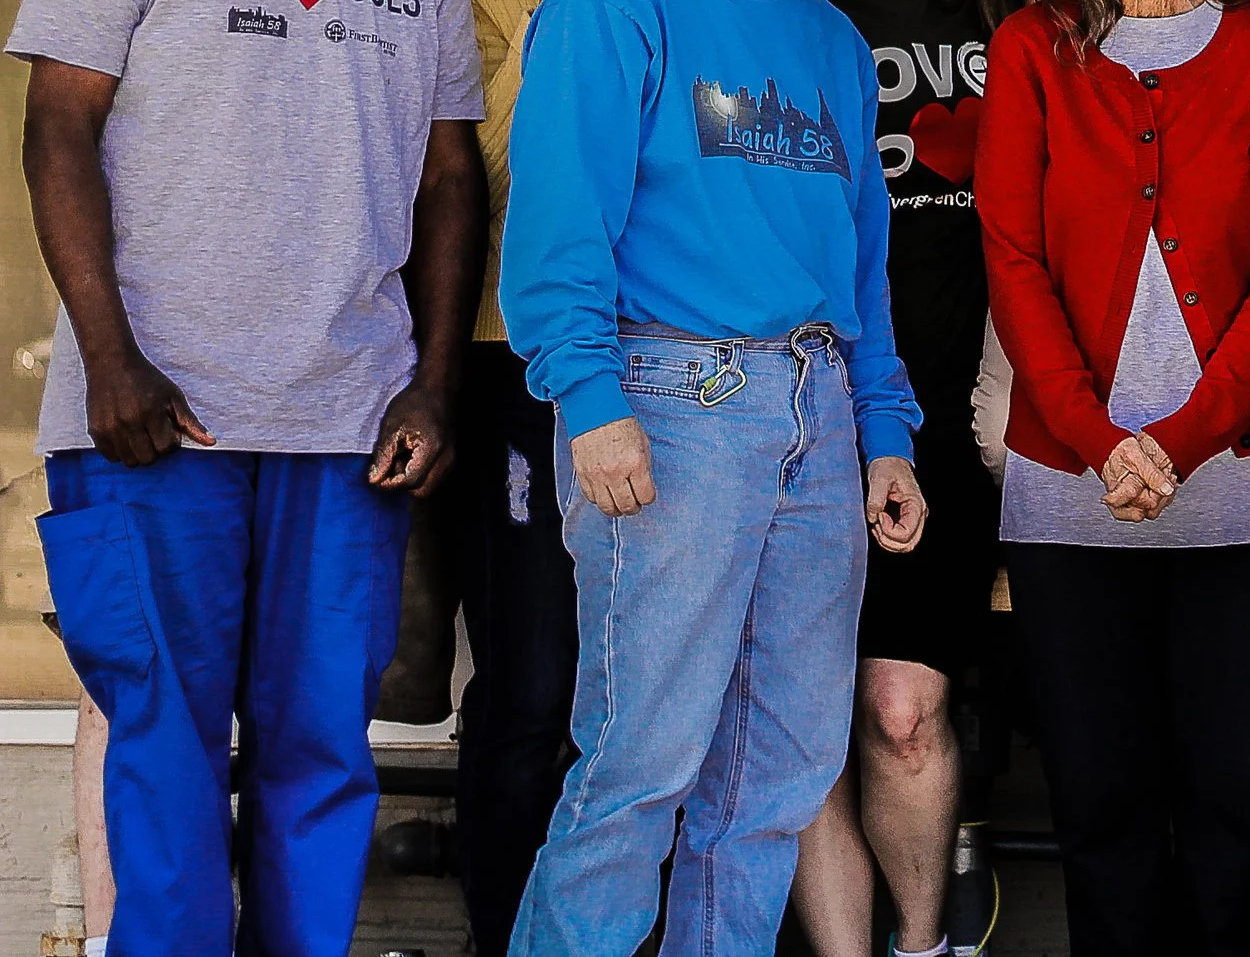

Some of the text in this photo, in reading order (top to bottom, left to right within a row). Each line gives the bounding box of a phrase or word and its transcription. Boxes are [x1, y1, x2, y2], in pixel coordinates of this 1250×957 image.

[266, 20, 282, 30] 58
[726, 112, 834, 160] Isaiah 58
